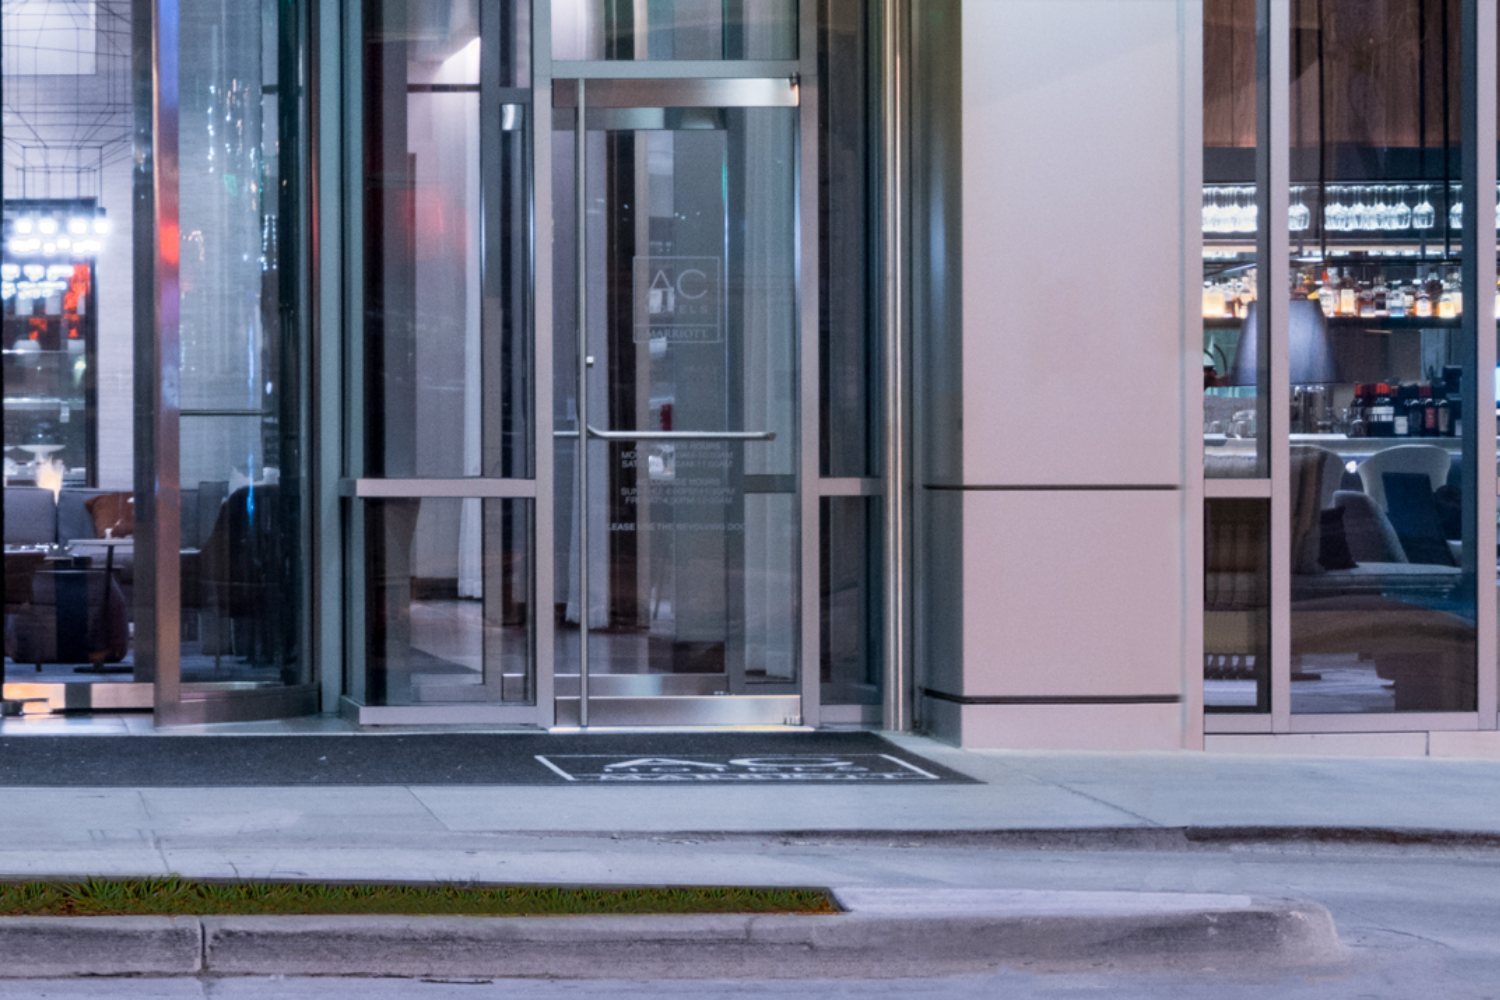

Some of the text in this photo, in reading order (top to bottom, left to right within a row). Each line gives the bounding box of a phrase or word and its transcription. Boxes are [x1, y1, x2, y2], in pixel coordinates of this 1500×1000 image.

[645, 269, 709, 300] AC
[645, 304, 709, 314] ELS
[604, 523, 635, 531] LEASE
